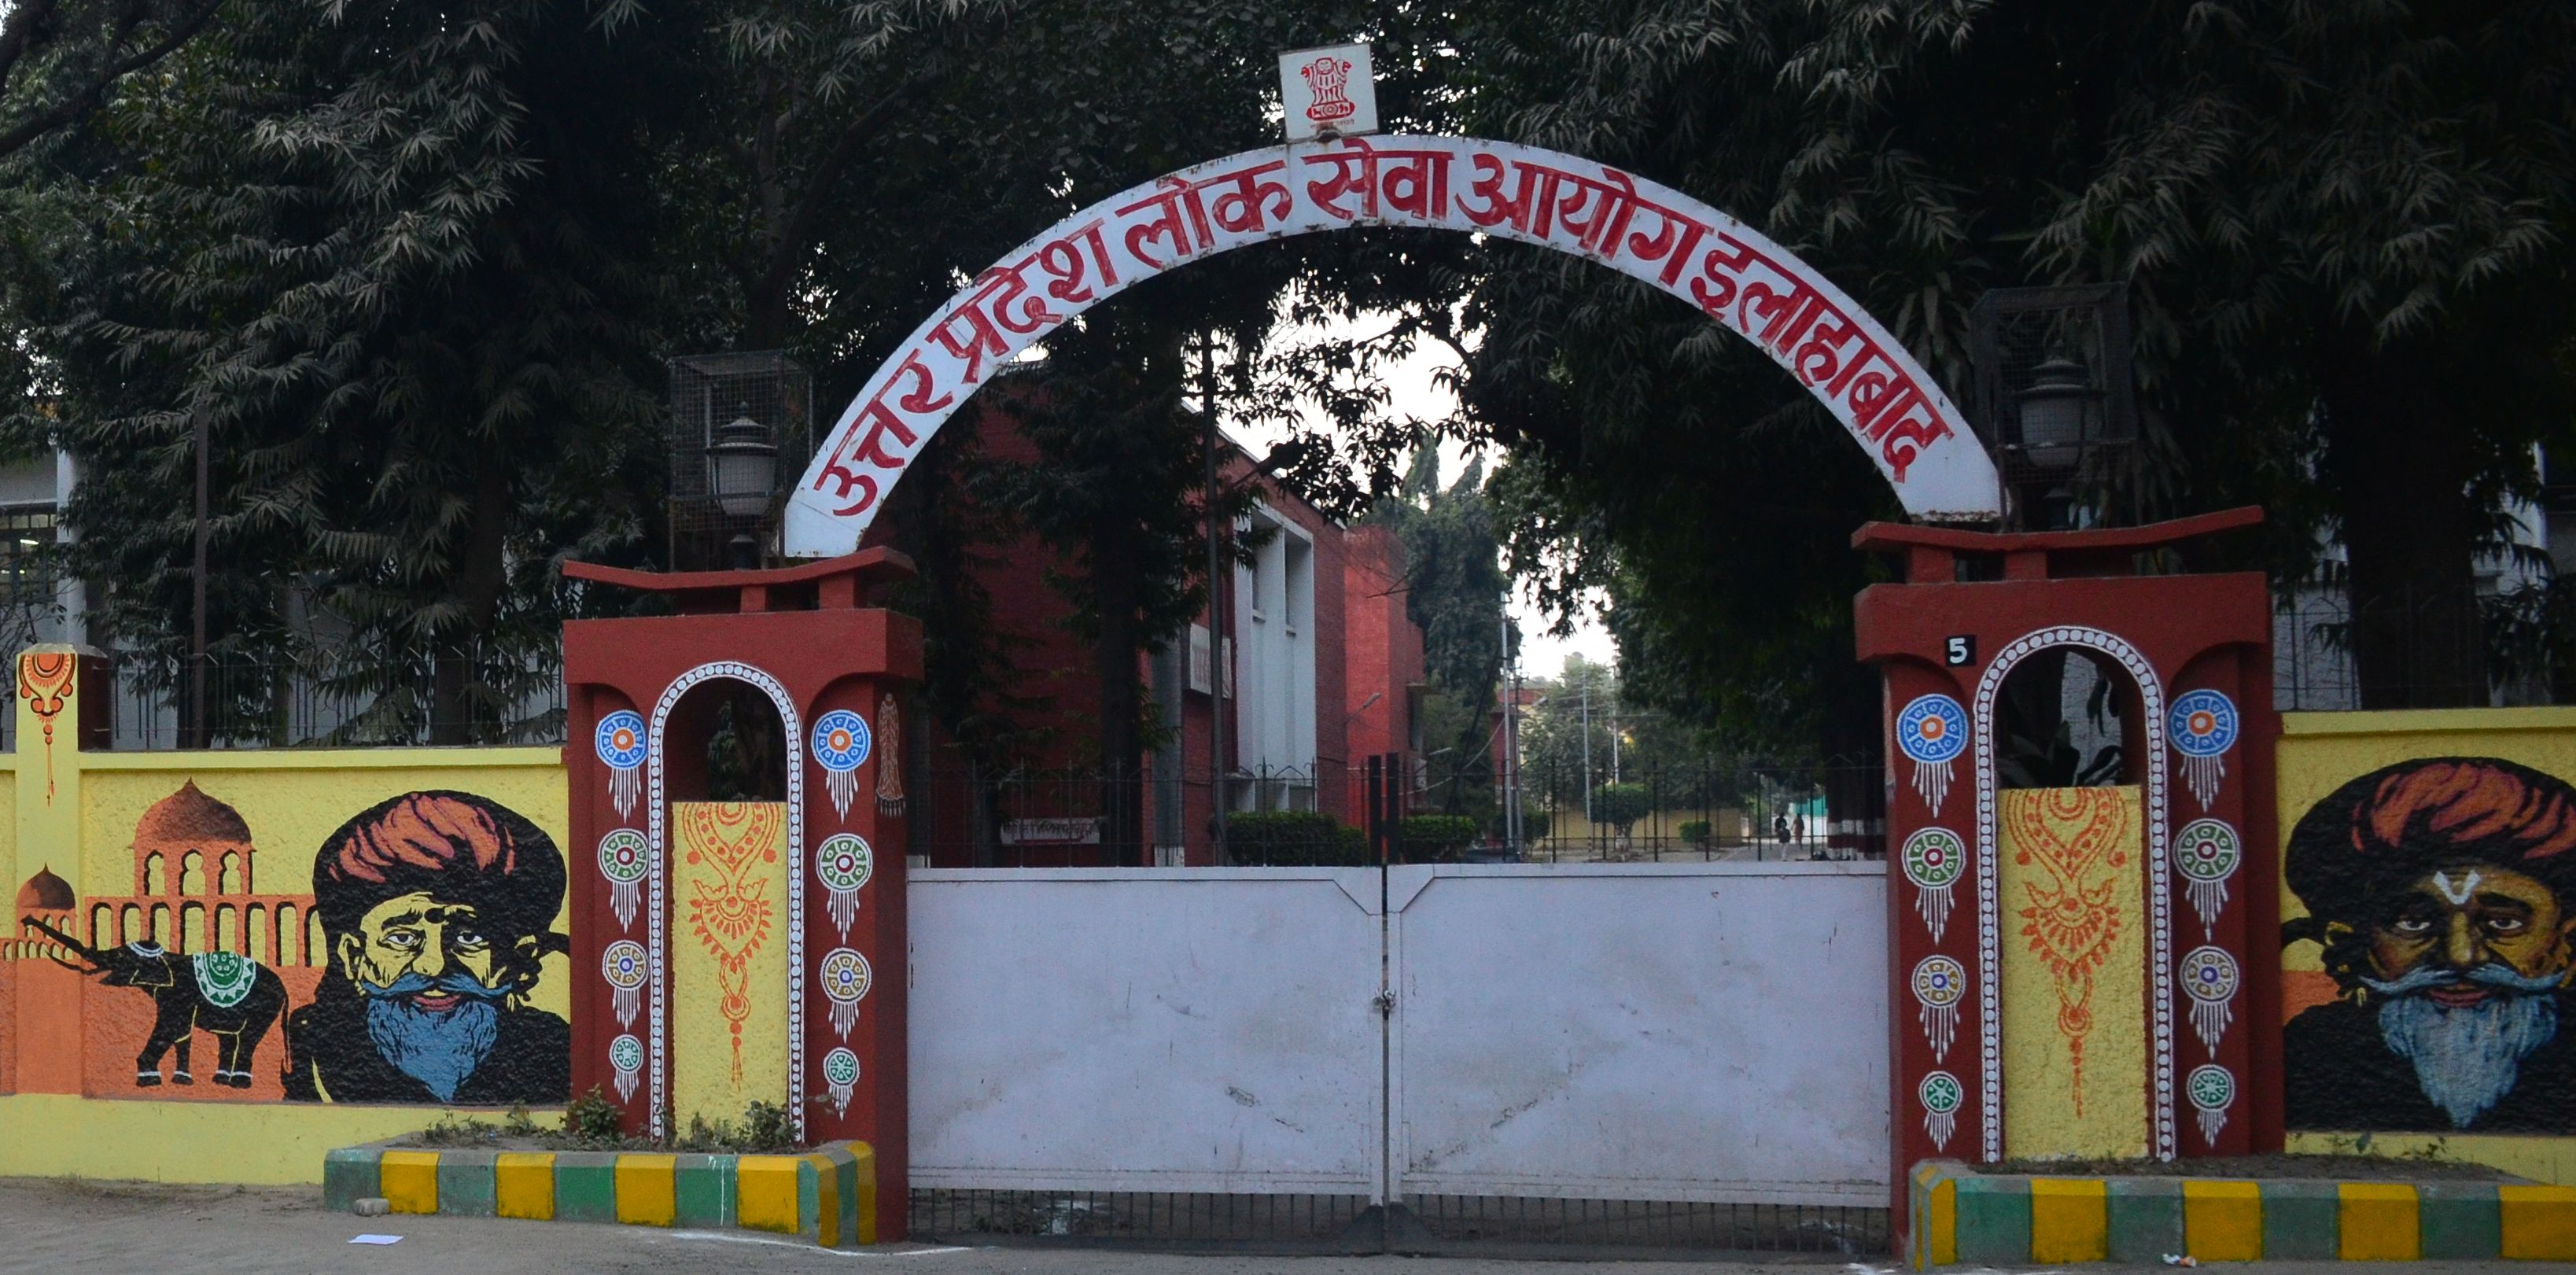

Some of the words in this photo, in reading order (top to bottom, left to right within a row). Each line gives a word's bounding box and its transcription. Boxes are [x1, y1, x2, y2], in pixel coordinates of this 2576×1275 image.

[813, 348, 953, 517] उत्तर
[927, 219, 1119, 384] प्रदेश
[1115, 160, 1293, 269] लोक
[1303, 138, 1454, 220] सेवा
[1454, 153, 1714, 286] आयोग
[1690, 231, 1954, 483] इलाहाबाद
[1949, 637, 1967, 664] 5
